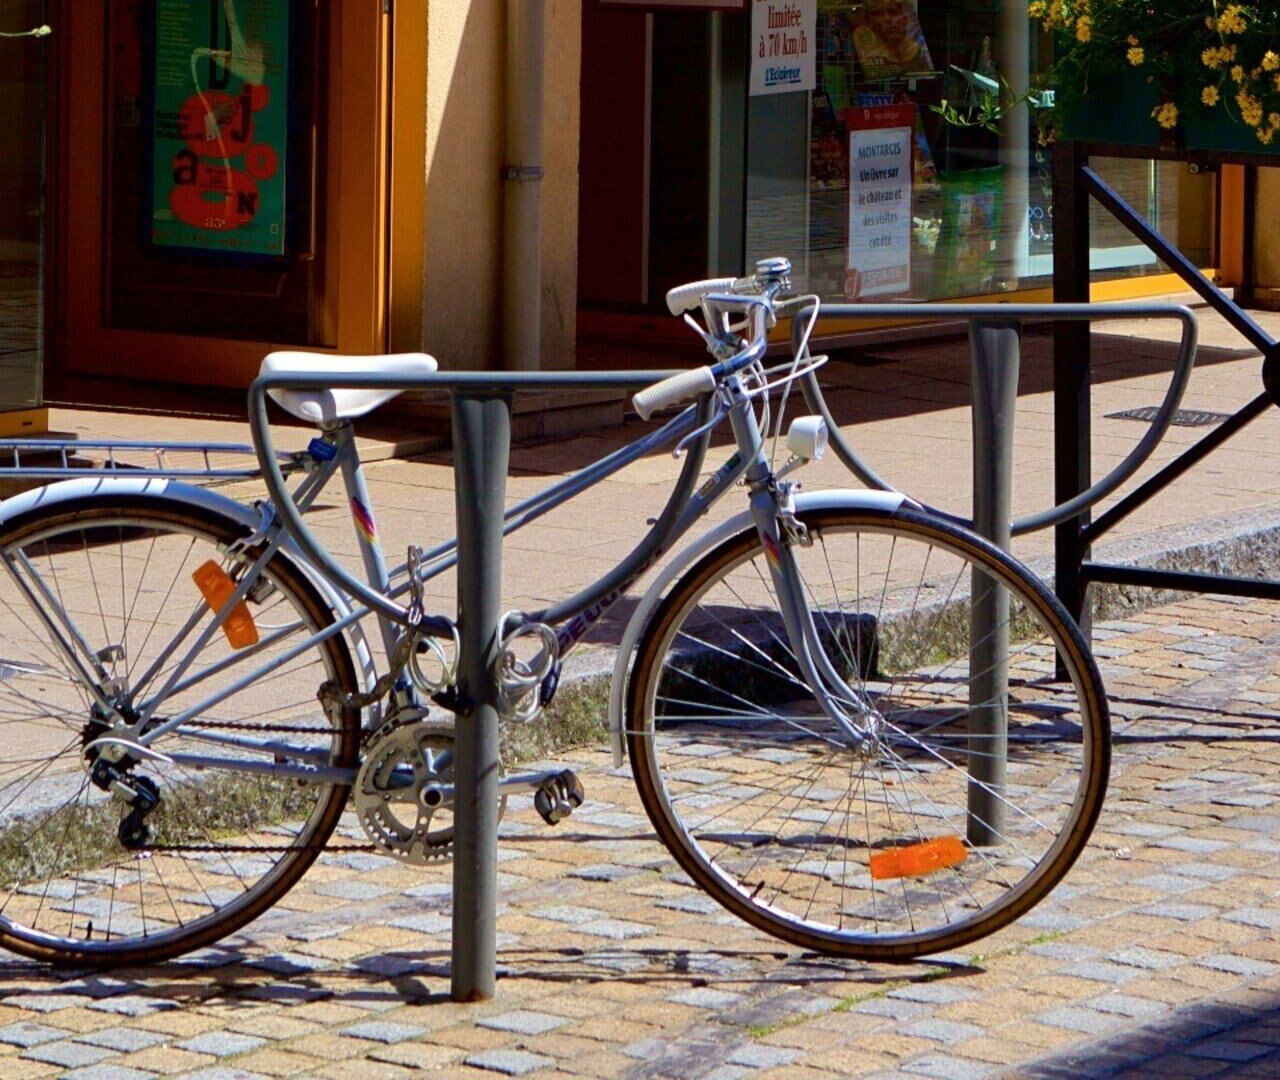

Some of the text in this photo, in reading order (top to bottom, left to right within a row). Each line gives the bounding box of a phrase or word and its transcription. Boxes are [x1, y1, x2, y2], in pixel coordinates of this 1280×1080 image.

[768, 3, 801, 29] limitée
[759, 30, 807, 59] à 70 km/h
[858, 142, 901, 160] MONTARGIS
[860, 167, 899, 182] Un livre sur
[858, 188, 902, 205] le château et
